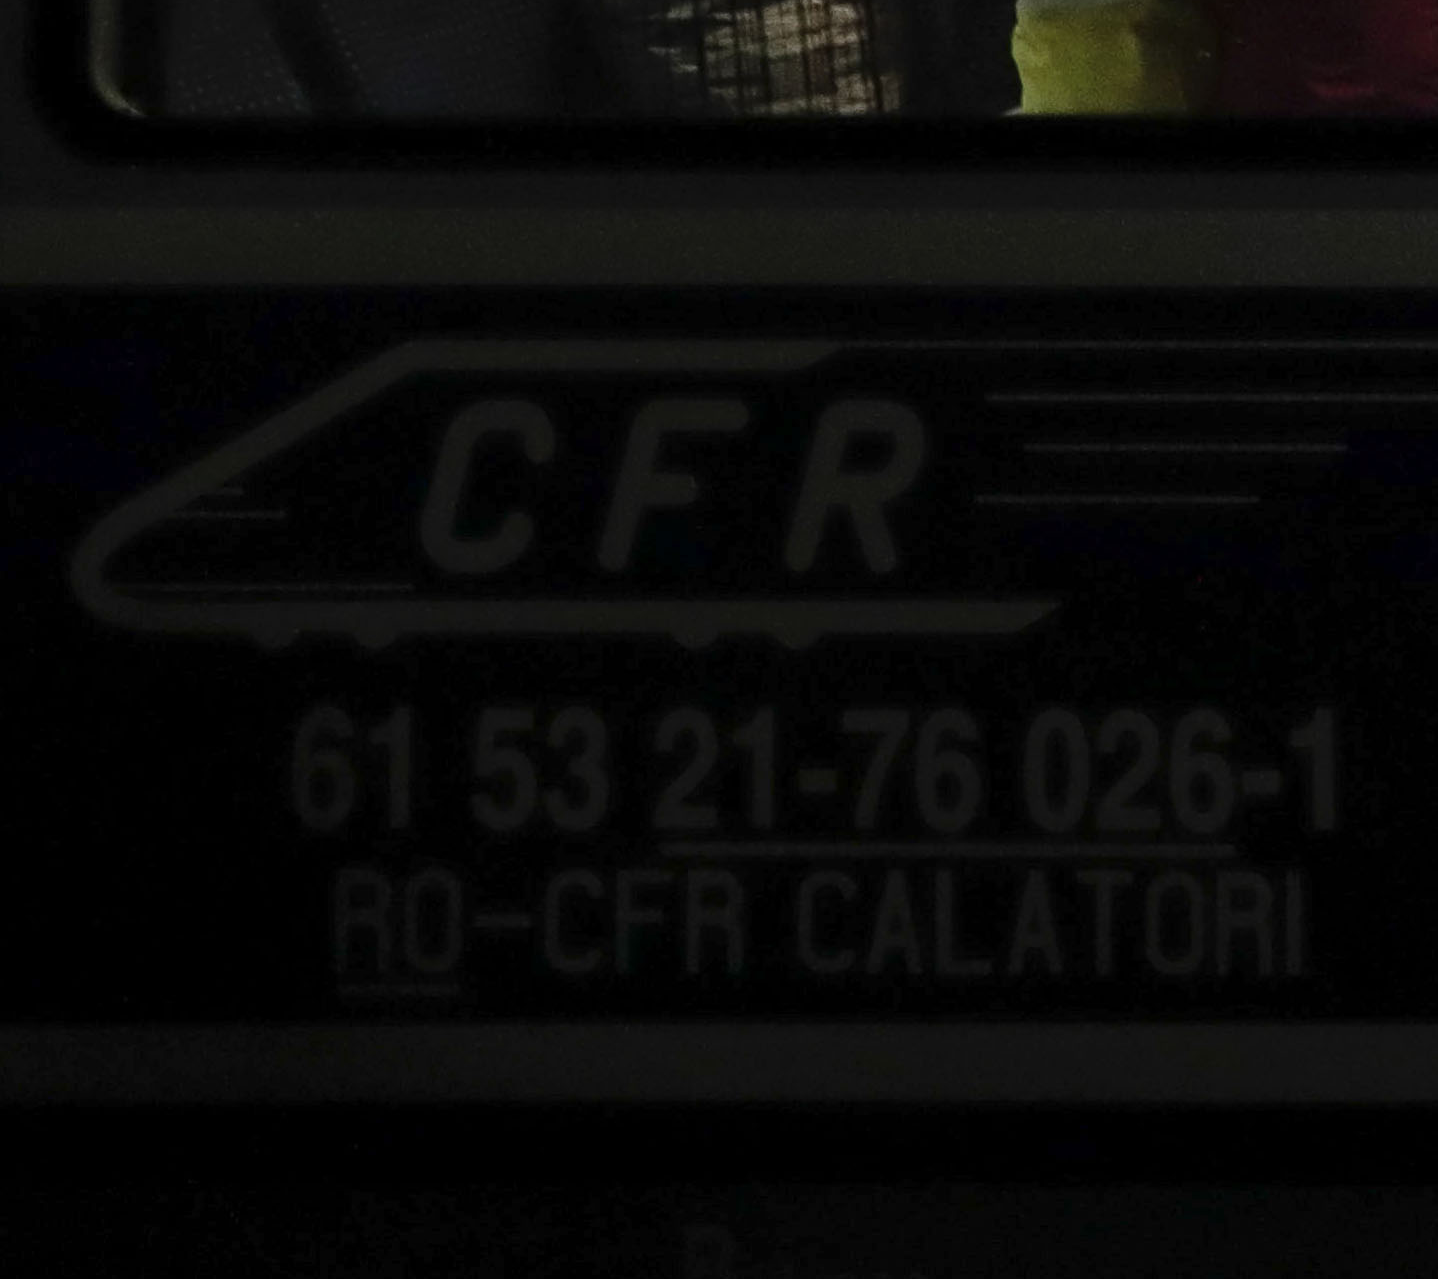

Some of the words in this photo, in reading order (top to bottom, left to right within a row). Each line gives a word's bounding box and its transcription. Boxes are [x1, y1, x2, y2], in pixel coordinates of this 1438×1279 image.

[418, 396, 929, 575] CFR
[290, 704, 415, 832] 61
[470, 704, 612, 833] 53
[652, 704, 983, 833] 21-76
[1021, 704, 1340, 833] 026-1
[333, 867, 748, 977] RO-CFR
[795, 866, 1306, 977] CALATORI
